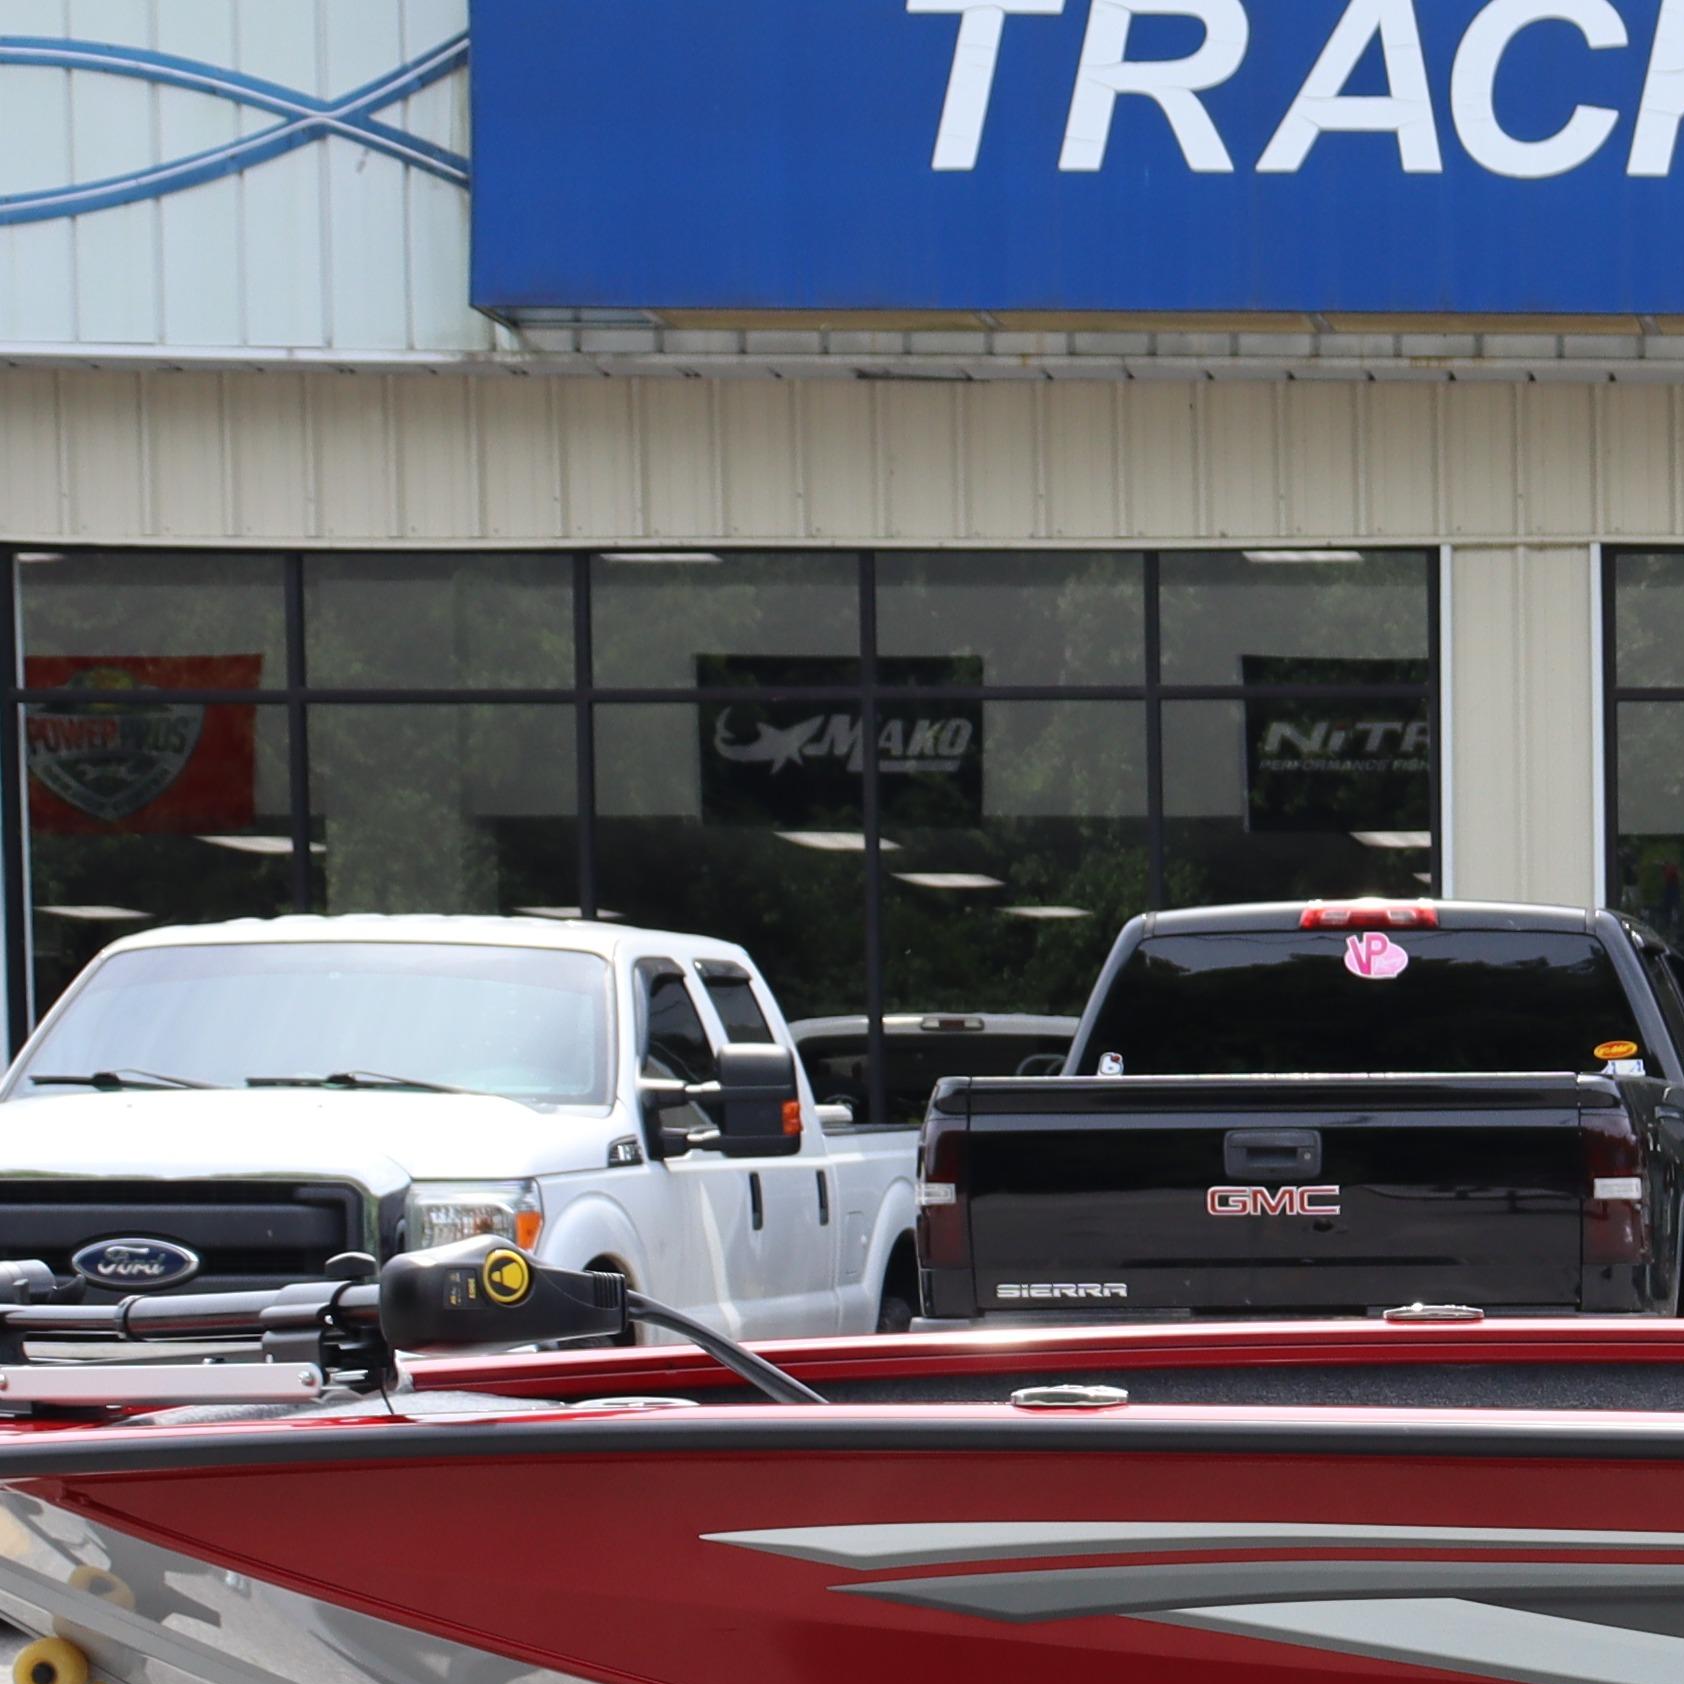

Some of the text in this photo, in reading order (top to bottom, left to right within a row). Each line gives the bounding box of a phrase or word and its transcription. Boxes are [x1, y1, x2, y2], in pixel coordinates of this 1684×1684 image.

[801, 713, 974, 772] MAKO
[1347, 932, 1389, 976] VP
[1206, 1185, 1341, 1216] GMC
[97, 1244, 168, 1276] Ford
